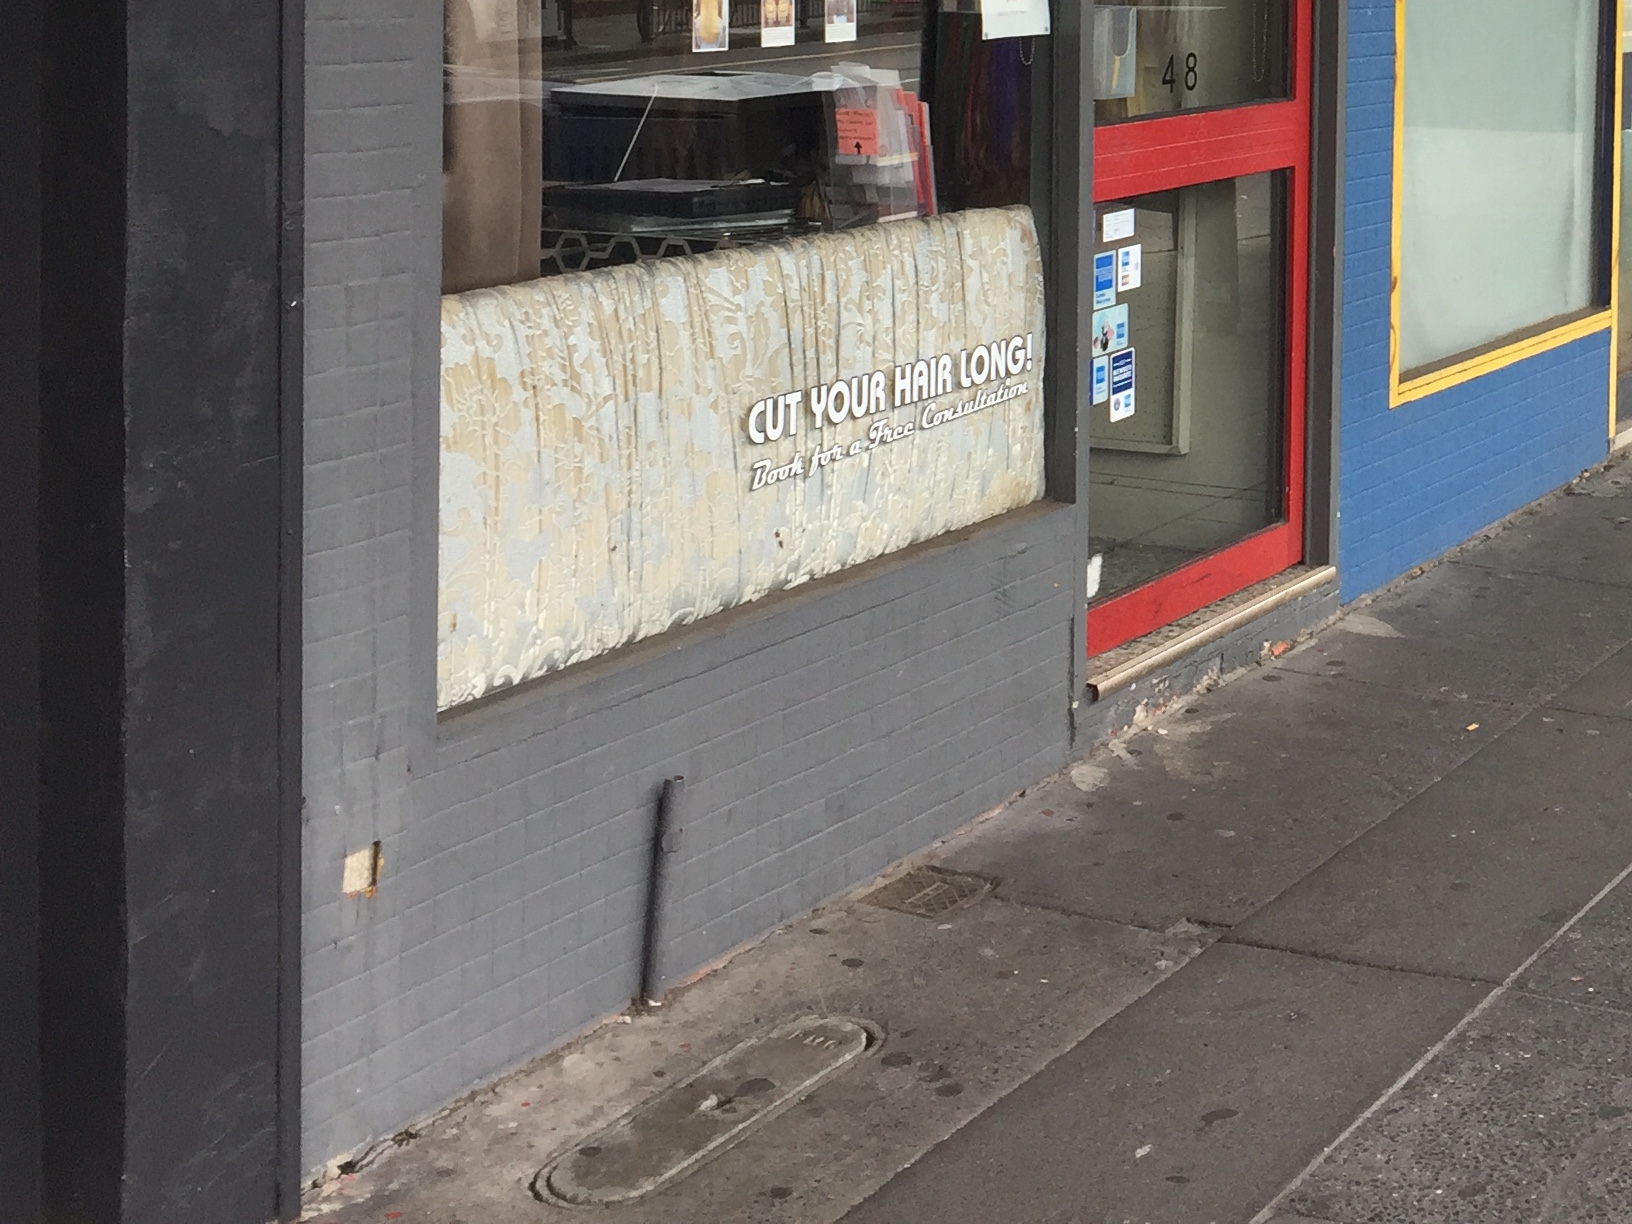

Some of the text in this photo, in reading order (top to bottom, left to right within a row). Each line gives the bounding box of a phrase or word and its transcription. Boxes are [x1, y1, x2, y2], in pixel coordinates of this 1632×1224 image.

[748, 332, 1034, 444] CUT YOUR HAIR LONG!
[751, 378, 1029, 492] Book for a Free Consultation
